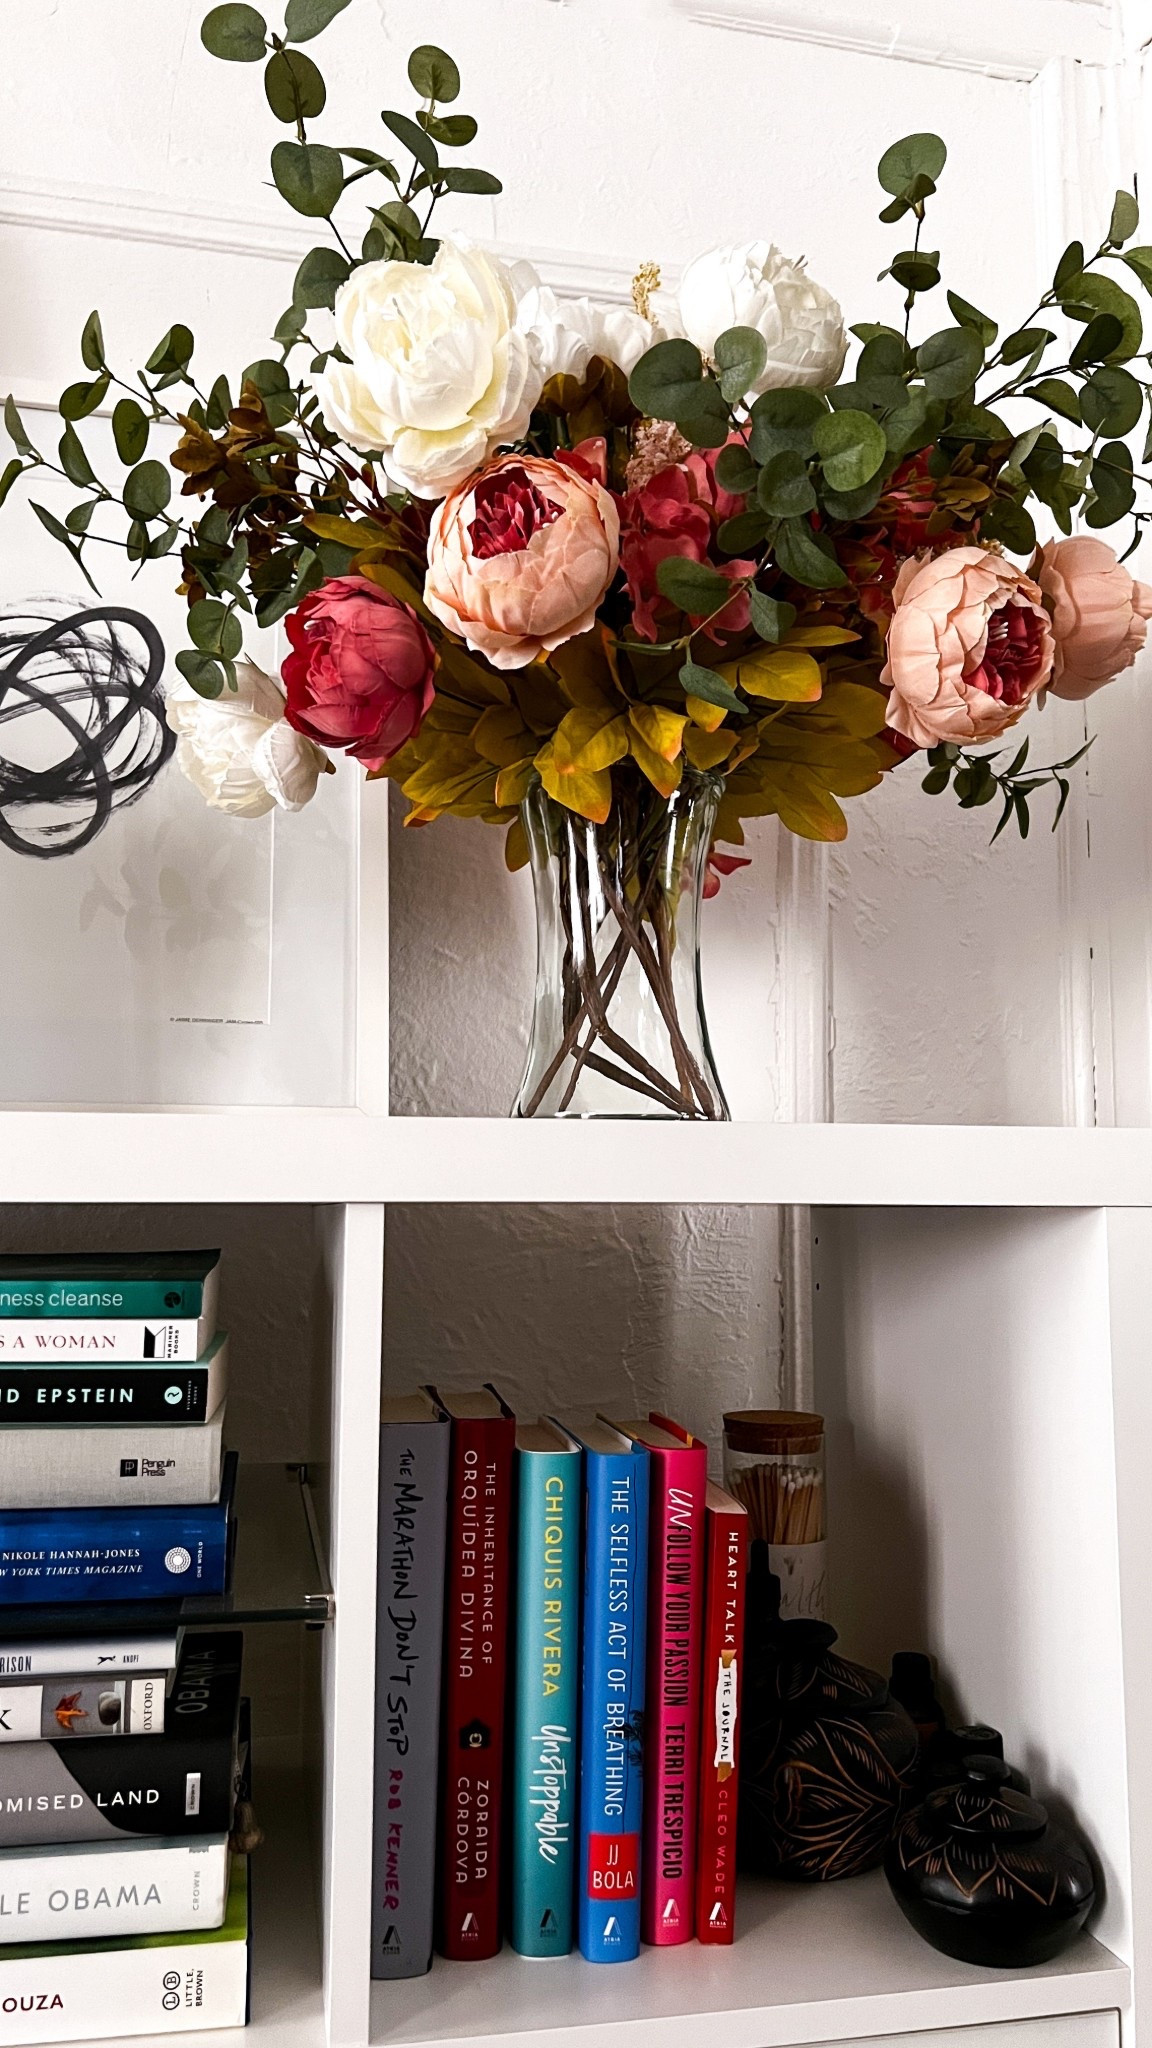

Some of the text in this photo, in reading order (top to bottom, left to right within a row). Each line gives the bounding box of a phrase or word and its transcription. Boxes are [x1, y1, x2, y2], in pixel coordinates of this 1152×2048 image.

[49, 1290, 124, 1307] cleanse
[13, 1335, 26, 1349] A
[36, 1334, 117, 1349] WOMAN
[37, 1387, 135, 1404] EPSTEIN
[141, 1458, 176, 1471] Penguin
[141, 1467, 167, 1477] Press
[2, 1549, 140, 1561] NIKOLE HANNAH-JONES
[12, 1567, 42, 1577] YORK
[45, 1566, 81, 1576] TIMES
[83, 1564, 144, 1575] MAGAZINE
[459, 1449, 480, 1678] ORQUÍDEA DIVINA
[481, 1462, 497, 1665] THE INHERITANCE OF
[386, 1448, 425, 1757] THE MARATHON DON'T STOP
[542, 1476, 564, 1697] CHIQUIS RIVERA
[724, 1531, 739, 1643] HEART TALK
[664, 1591, 691, 1633] YOUR
[123, 1654, 140, 1665] KNOPF
[603, 1476, 630, 1817] THE SELFLESS ACT OF BREATHING
[175, 1650, 216, 1715] OBAMA
[664, 1639, 690, 1707] PASSION
[143, 1682, 154, 1731] OXFORD
[719, 1671, 732, 1760] THE JOURNAL
[0, 1789, 161, 1813] MISED LAND
[662, 1722, 686, 1879] TERRI TRESPICIO
[382, 1768, 405, 1911] ROB KENNER
[455, 1777, 473, 1884] CÓRDOVA
[475, 1779, 490, 1880] ZORAIDA
[714, 1790, 728, 1894] CLEO WADE
[606, 1844, 619, 1866] JJ
[48, 1883, 163, 1912] OBAMA
[192, 1870, 201, 1911] CROWN
[593, 1870, 634, 1890] BOLA
[2, 1994, 64, 2014] OUZA
[195, 1969, 204, 2007] BROWN
